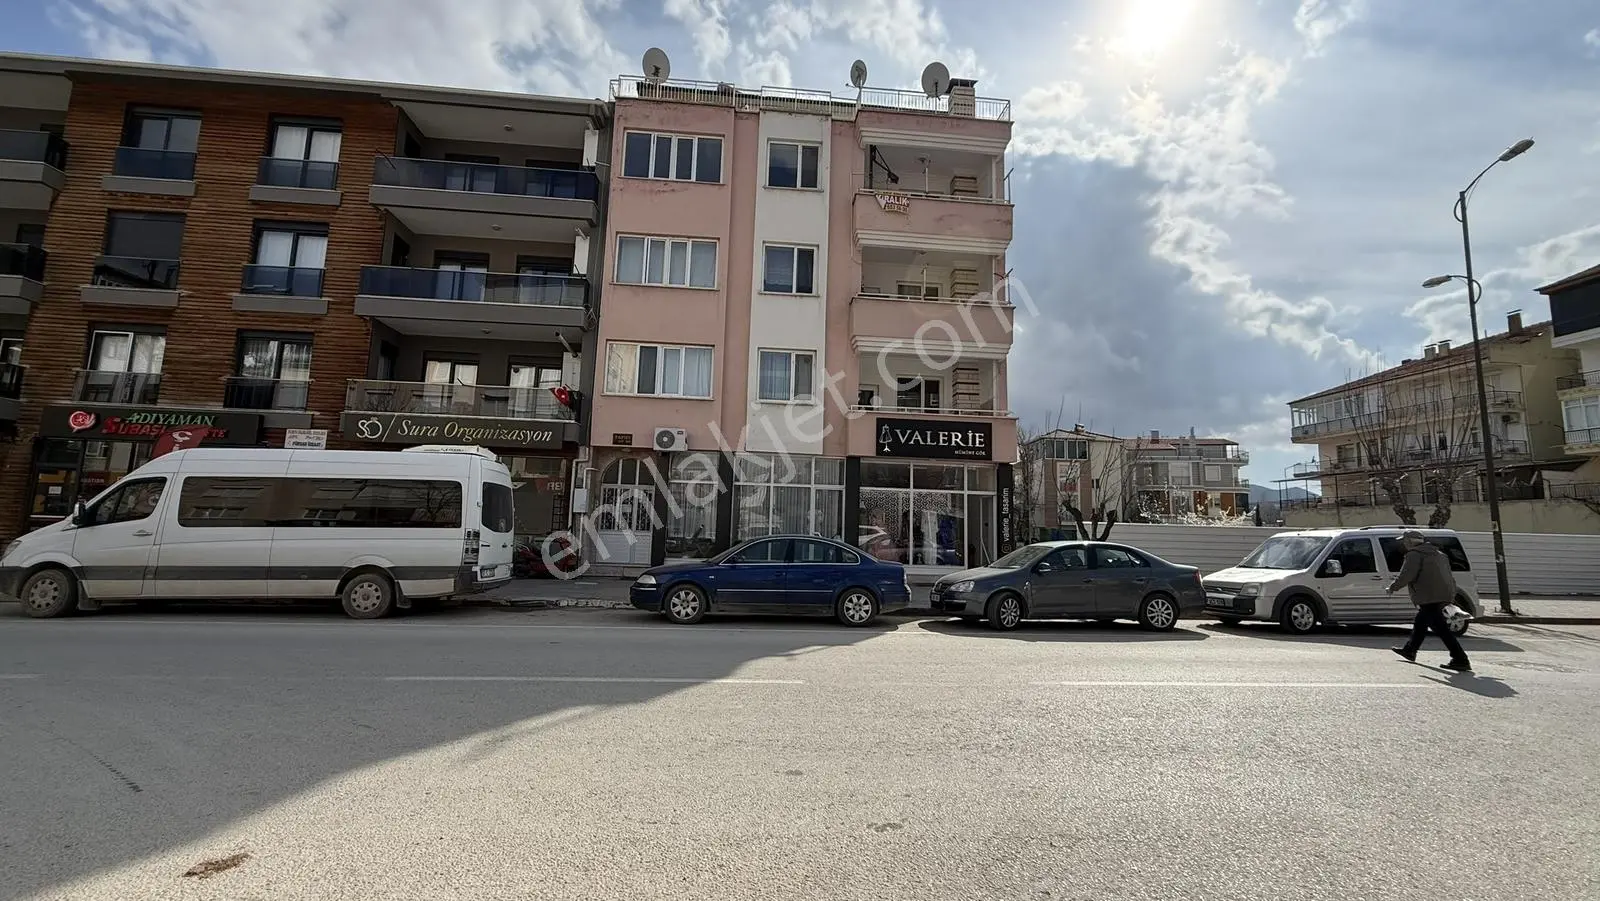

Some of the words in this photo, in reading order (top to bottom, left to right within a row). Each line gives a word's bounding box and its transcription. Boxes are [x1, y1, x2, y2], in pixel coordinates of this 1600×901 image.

[126, 412, 215, 427] ADIYAMAN
[398, 419, 438, 437] Sura
[444, 421, 553, 444] Organizasyon
